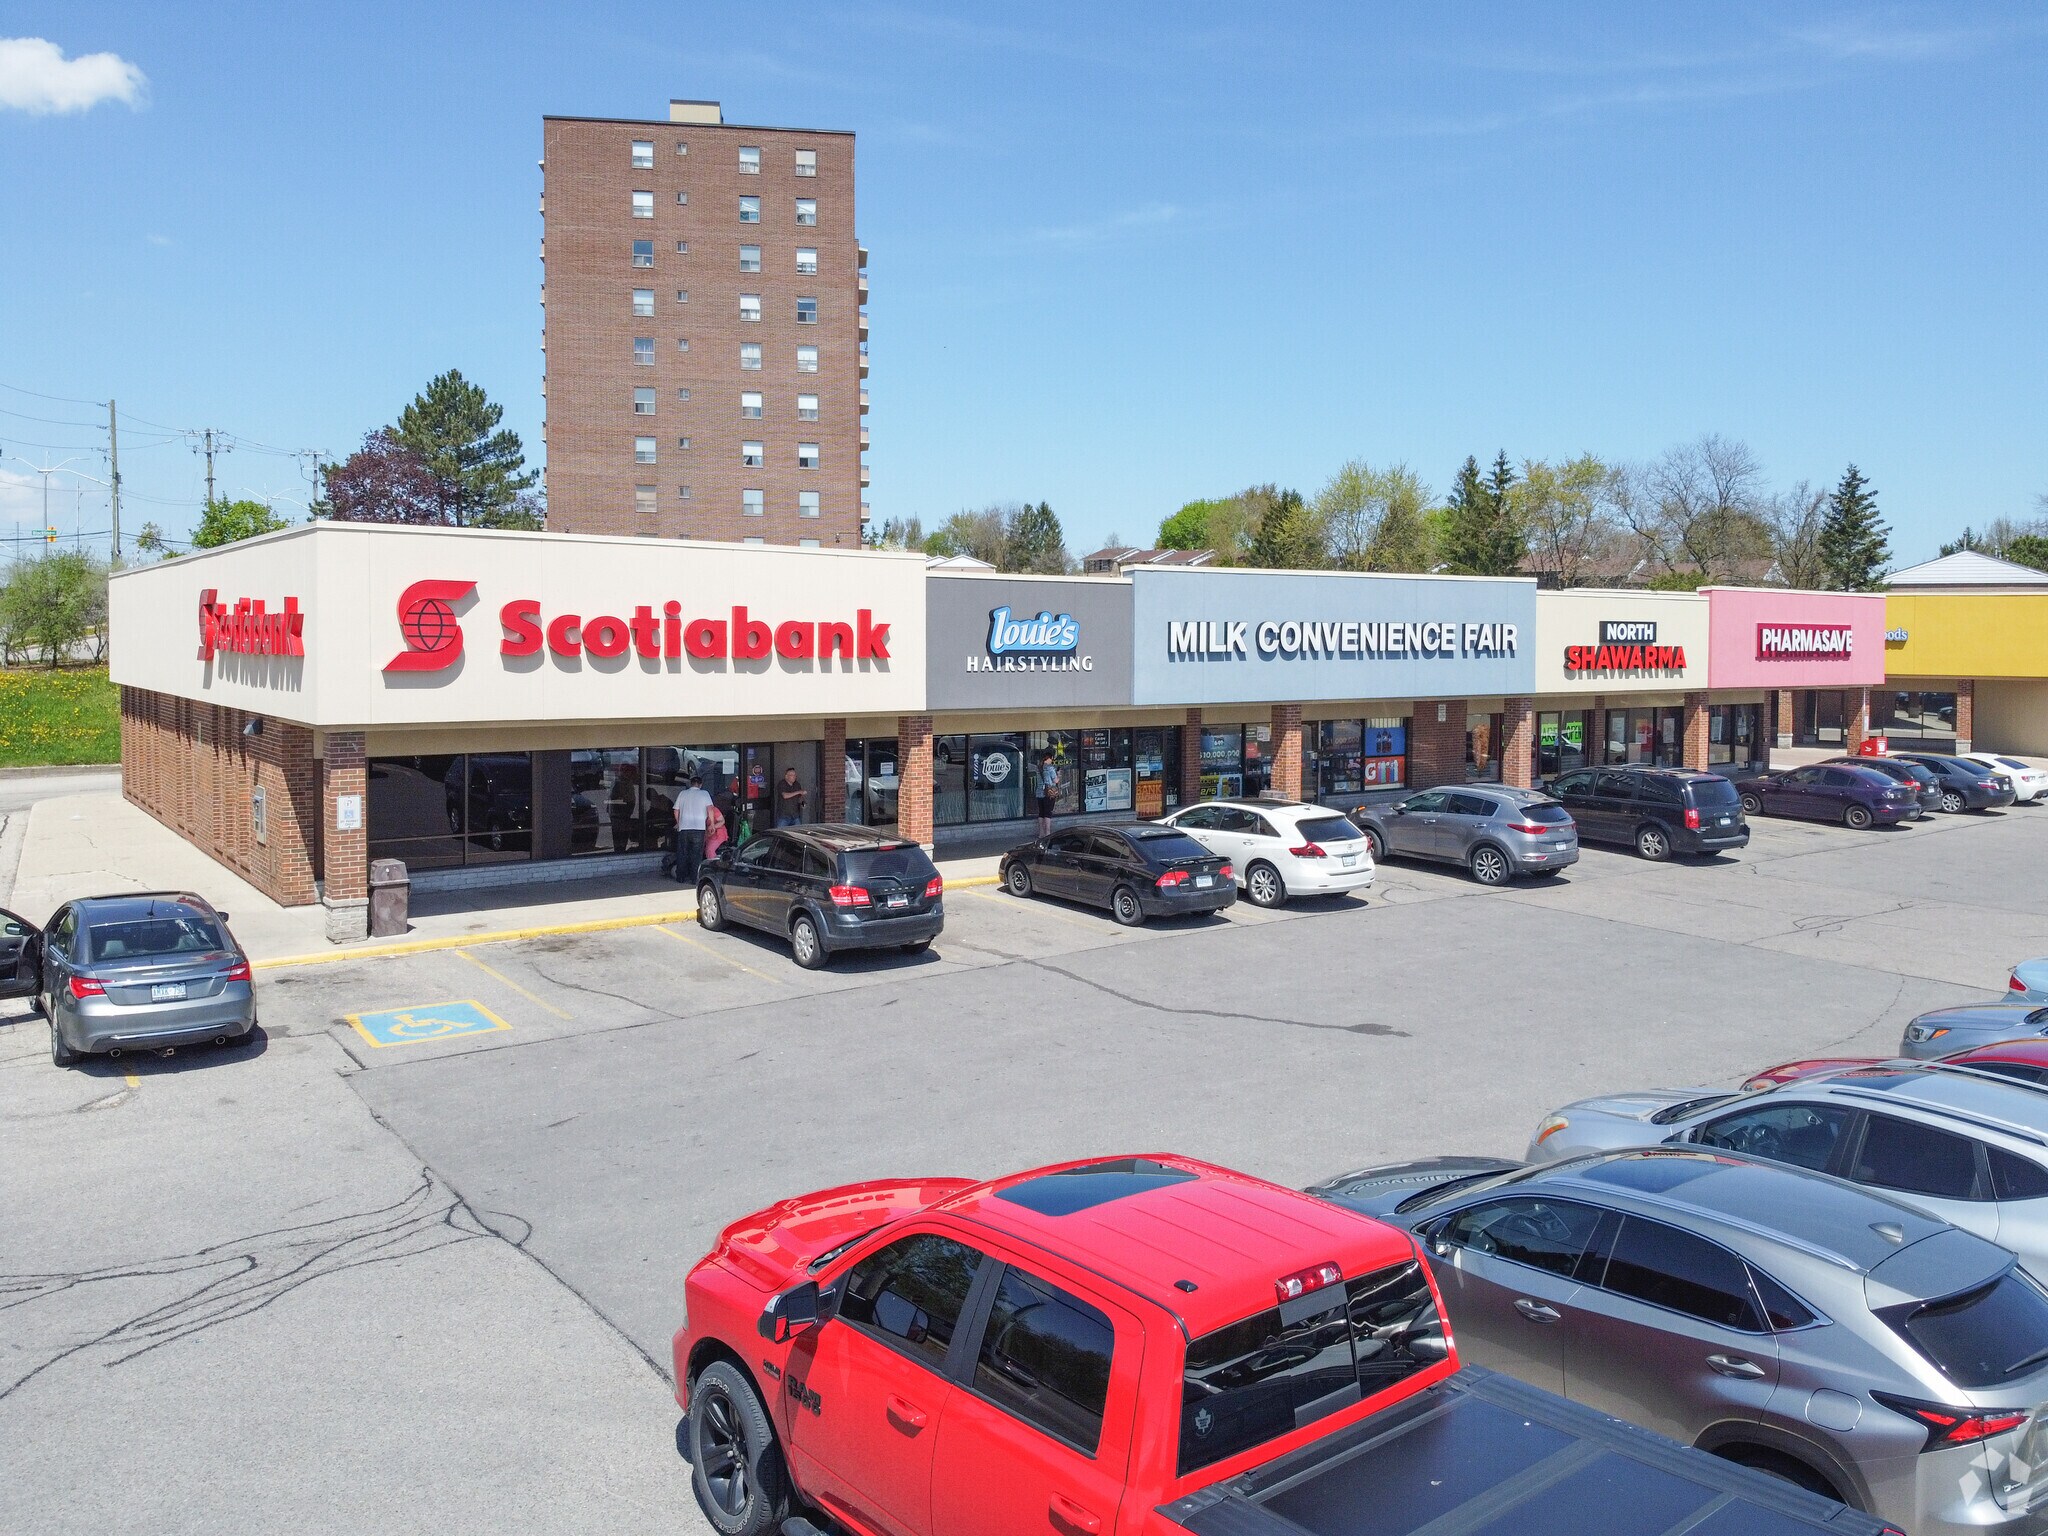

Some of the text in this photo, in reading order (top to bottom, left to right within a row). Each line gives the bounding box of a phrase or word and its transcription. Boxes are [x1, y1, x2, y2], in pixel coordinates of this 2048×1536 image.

[499, 599, 891, 660] Scotiabank
[993, 609, 1077, 650] louie's
[1169, 620, 1518, 653] MILK CONVENIENCE FAIR
[1606, 623, 1654, 640] NORTH
[1761, 628, 1852, 652] PHARMASAVE
[966, 655, 1094, 673] HAIRSTYLING
[1567, 645, 1687, 669] SHAWARMA
[1136, 784, 1162, 795] BANK
[788, 1375, 821, 1405] RAM
